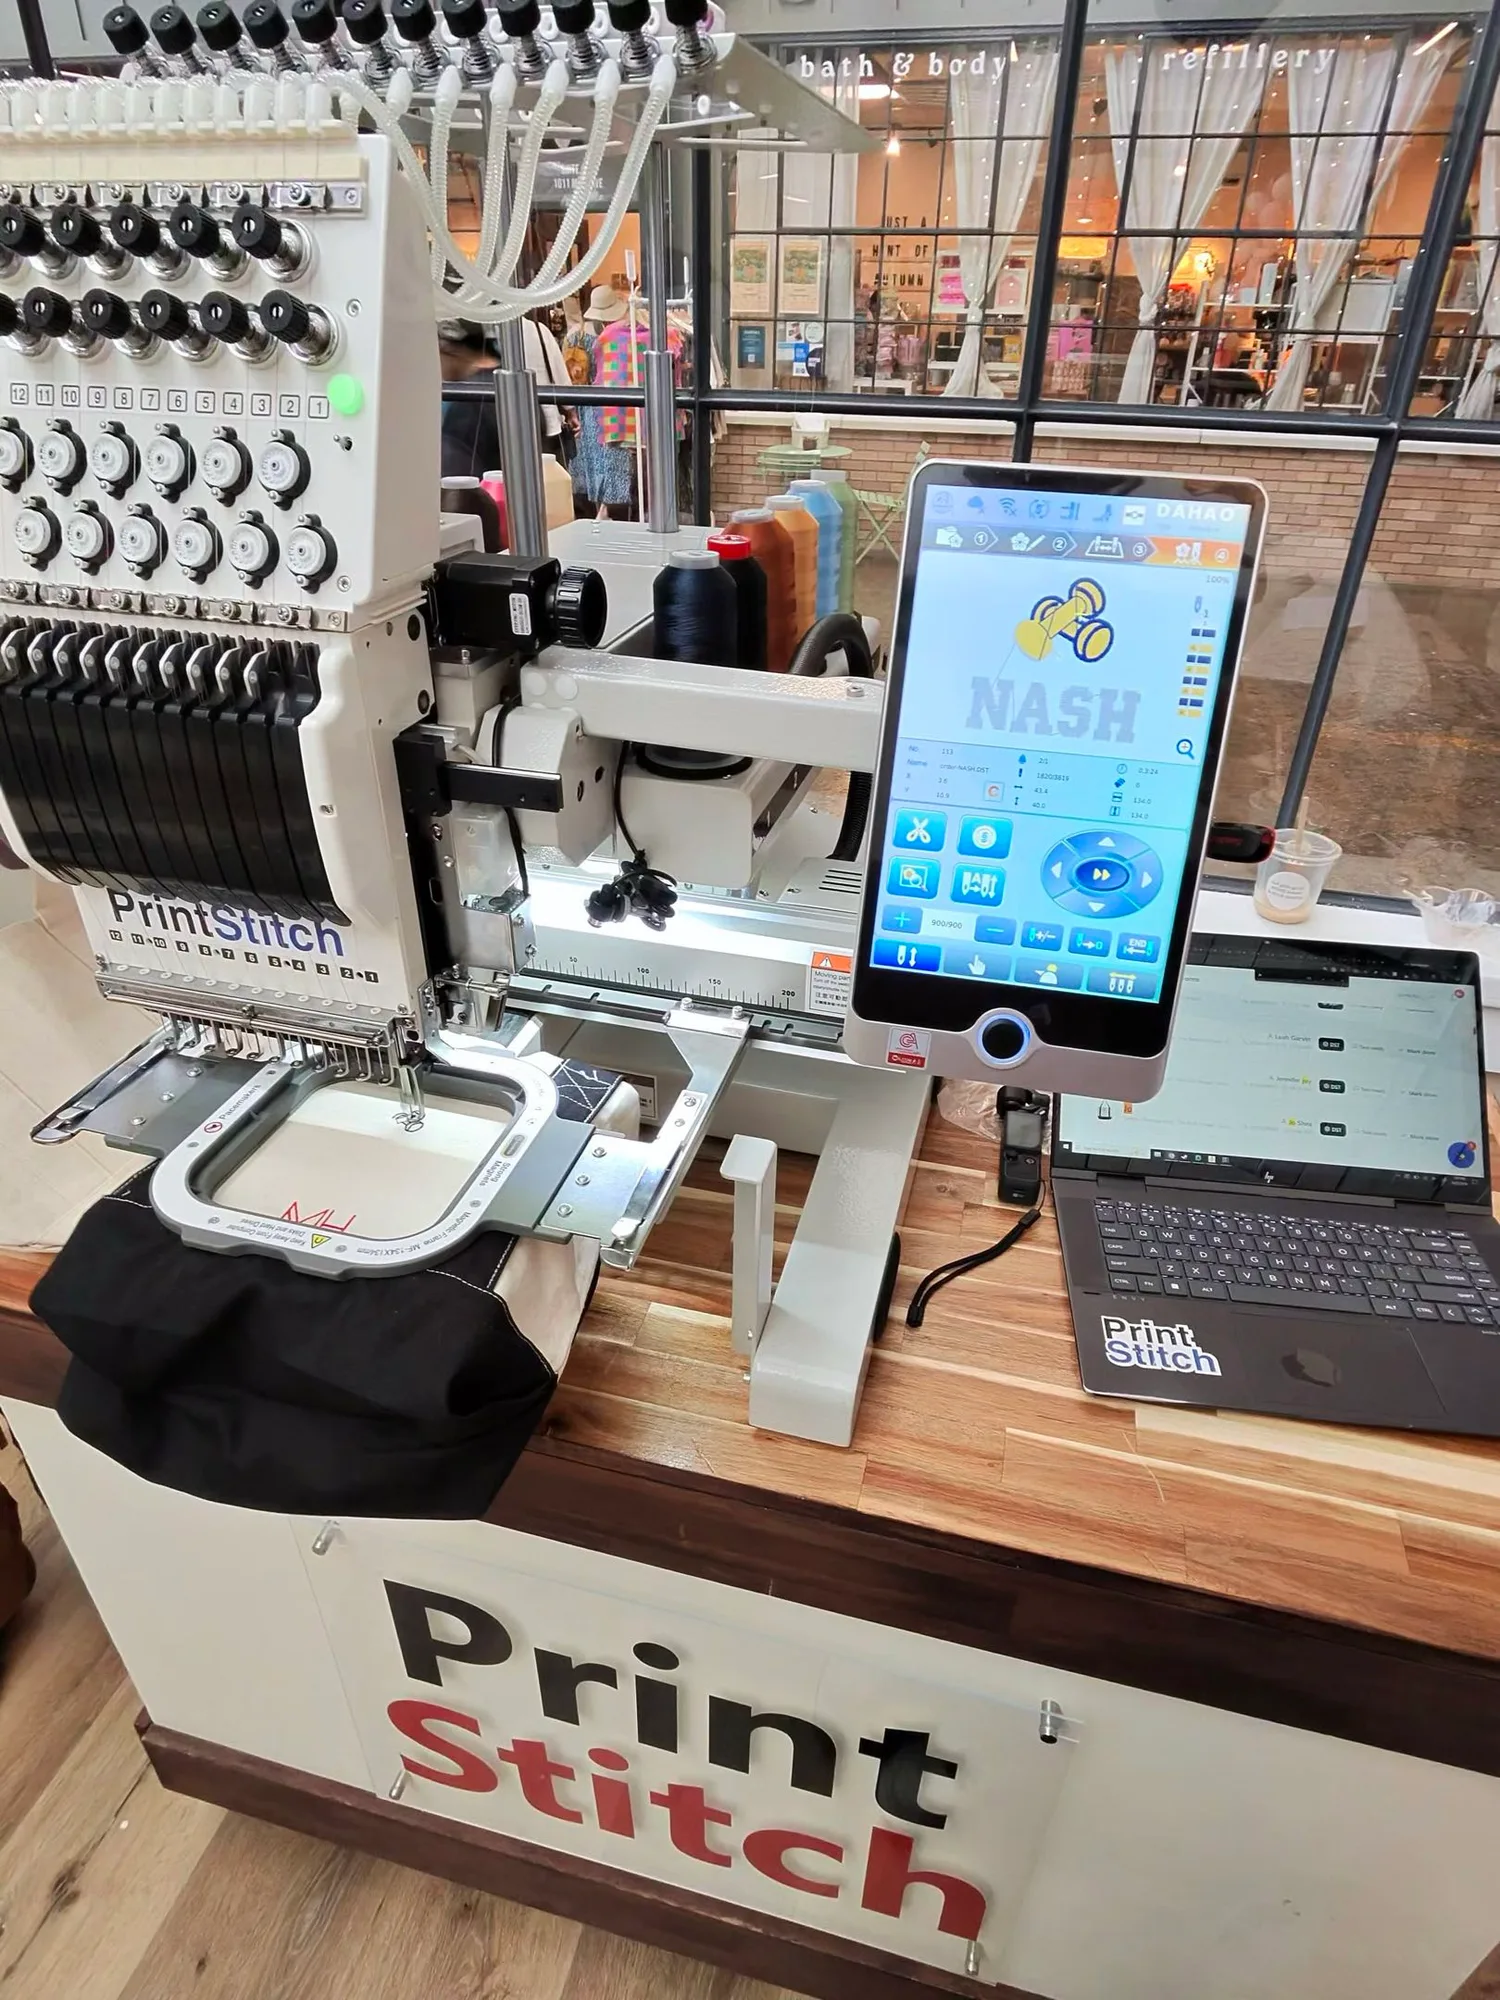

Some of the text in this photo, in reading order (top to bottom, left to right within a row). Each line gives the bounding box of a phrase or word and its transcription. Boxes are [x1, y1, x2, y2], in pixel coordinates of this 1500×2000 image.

[800, 51, 1006, 79] bath & body
[1162, 43, 1335, 74] refillery
[882, 216, 927, 228] UST A
[872, 244, 928, 258] HNT OF
[874, 273, 924, 286] AUTUMN
[13, 387, 322, 414] 12 11 10 9 8 7 6 5 4 3 2 1
[1157, 503, 1234, 521] DAHAO
[965, 676, 1141, 744] NASH
[931, 919, 963, 930] 900/900
[1128, 938, 1147, 948] END
[708, 978, 722, 986] 150
[815, 970, 838, 980] Moving
[781, 989, 796, 997] 200
[480, 1160, 502, 1186] Magnets
[1320, 1279, 1330, 1287] M
[1104, 1318, 1192, 1347] Print
[1107, 1340, 1216, 1372] Stitch
[384, 1579, 958, 1830] Print
[387, 1699, 987, 1941] Stitch
